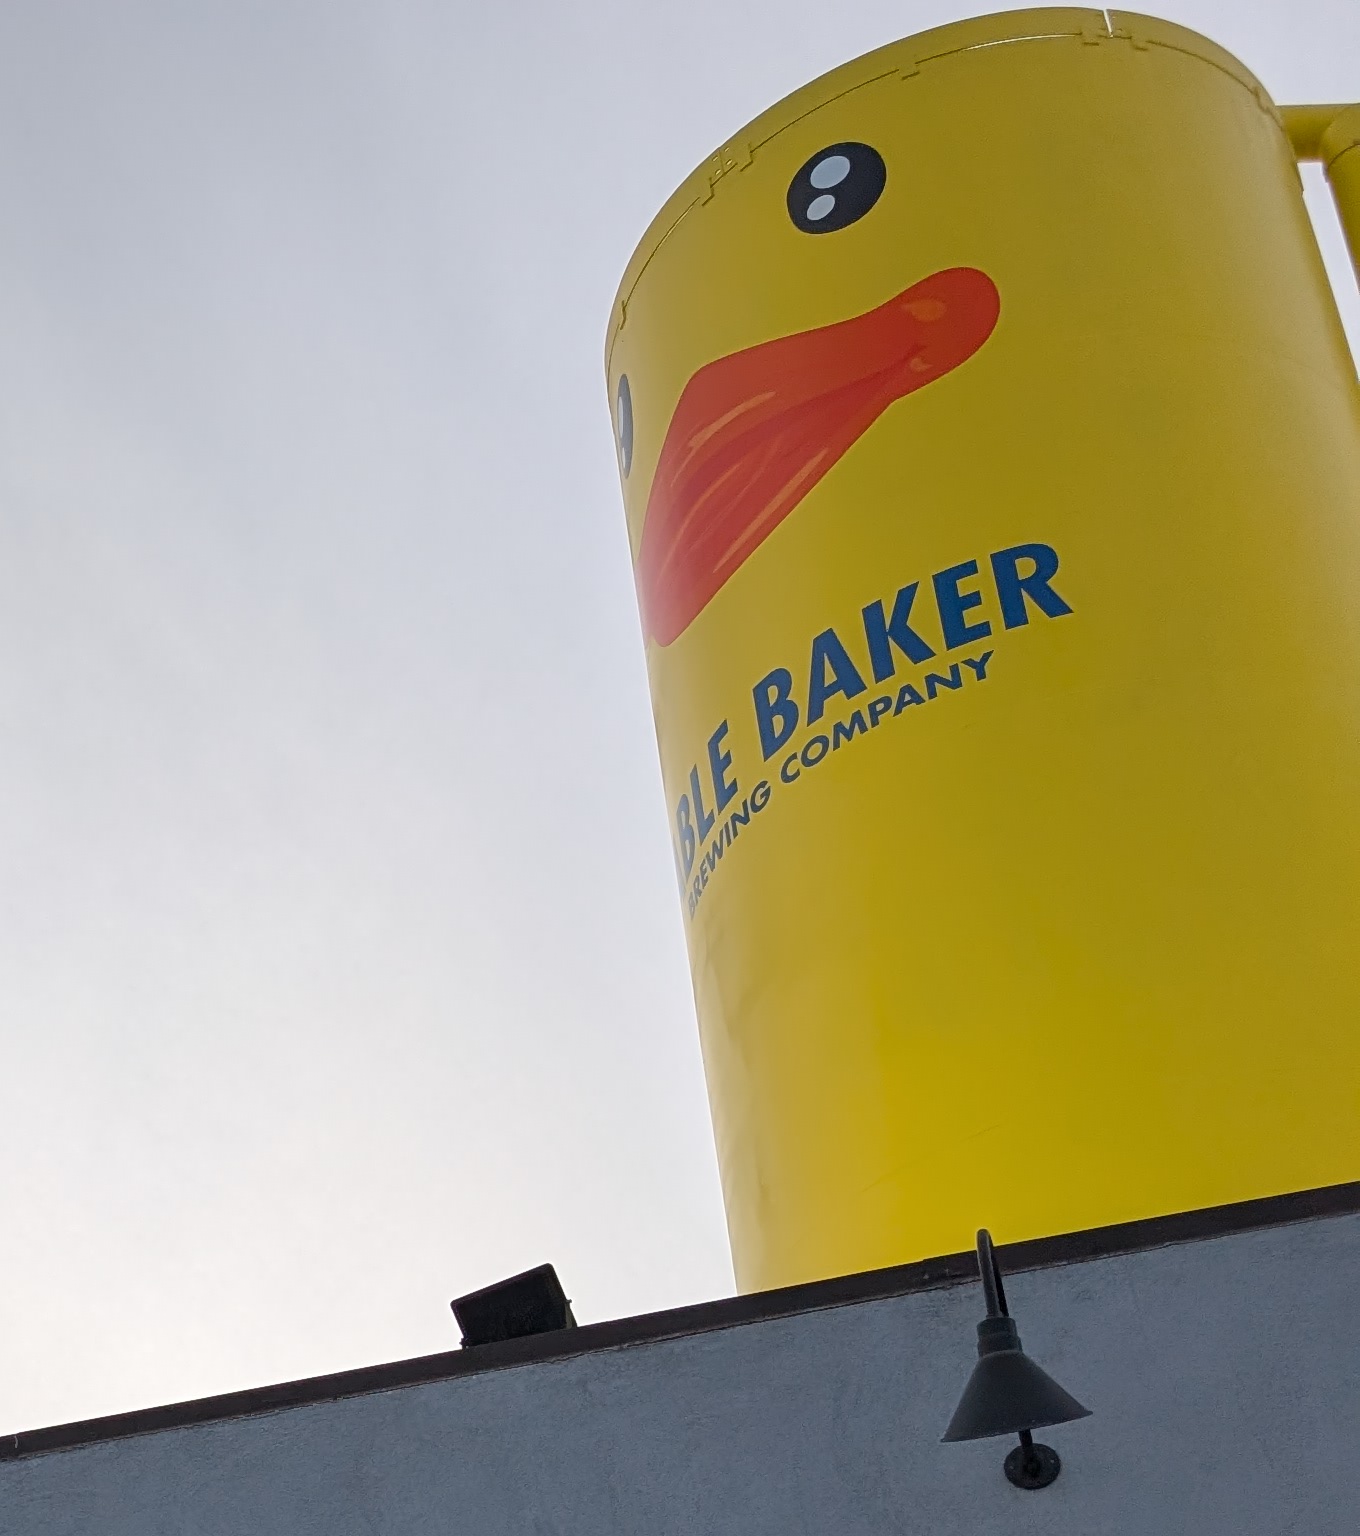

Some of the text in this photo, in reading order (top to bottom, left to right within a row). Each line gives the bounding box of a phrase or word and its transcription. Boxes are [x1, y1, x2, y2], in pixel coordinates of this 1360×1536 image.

[673, 543, 1075, 892] BLE BAKER
[688, 649, 995, 921] BREWING COMPANY
